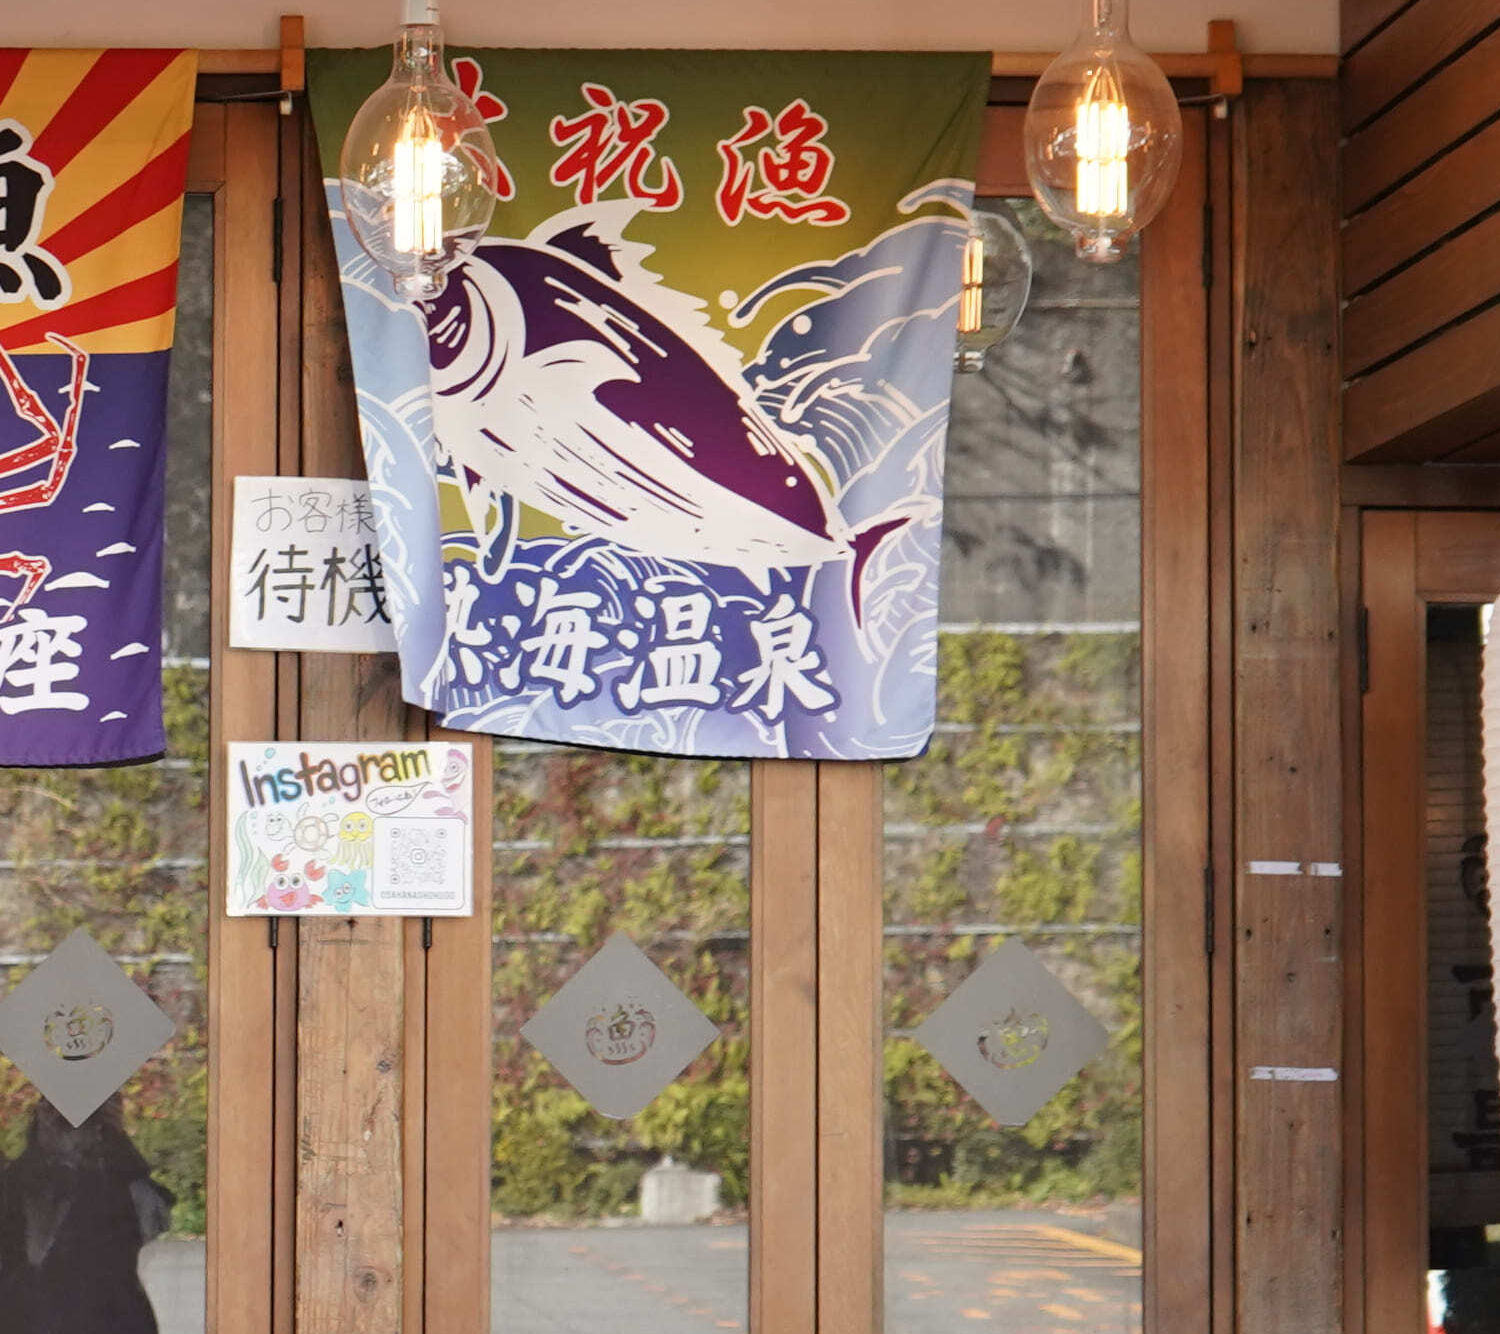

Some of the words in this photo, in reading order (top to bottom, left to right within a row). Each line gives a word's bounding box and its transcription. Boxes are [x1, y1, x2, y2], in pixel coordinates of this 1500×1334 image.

[252, 488, 376, 535] お客様
[245, 544, 392, 626] 待機
[237, 745, 436, 810] Instagram
